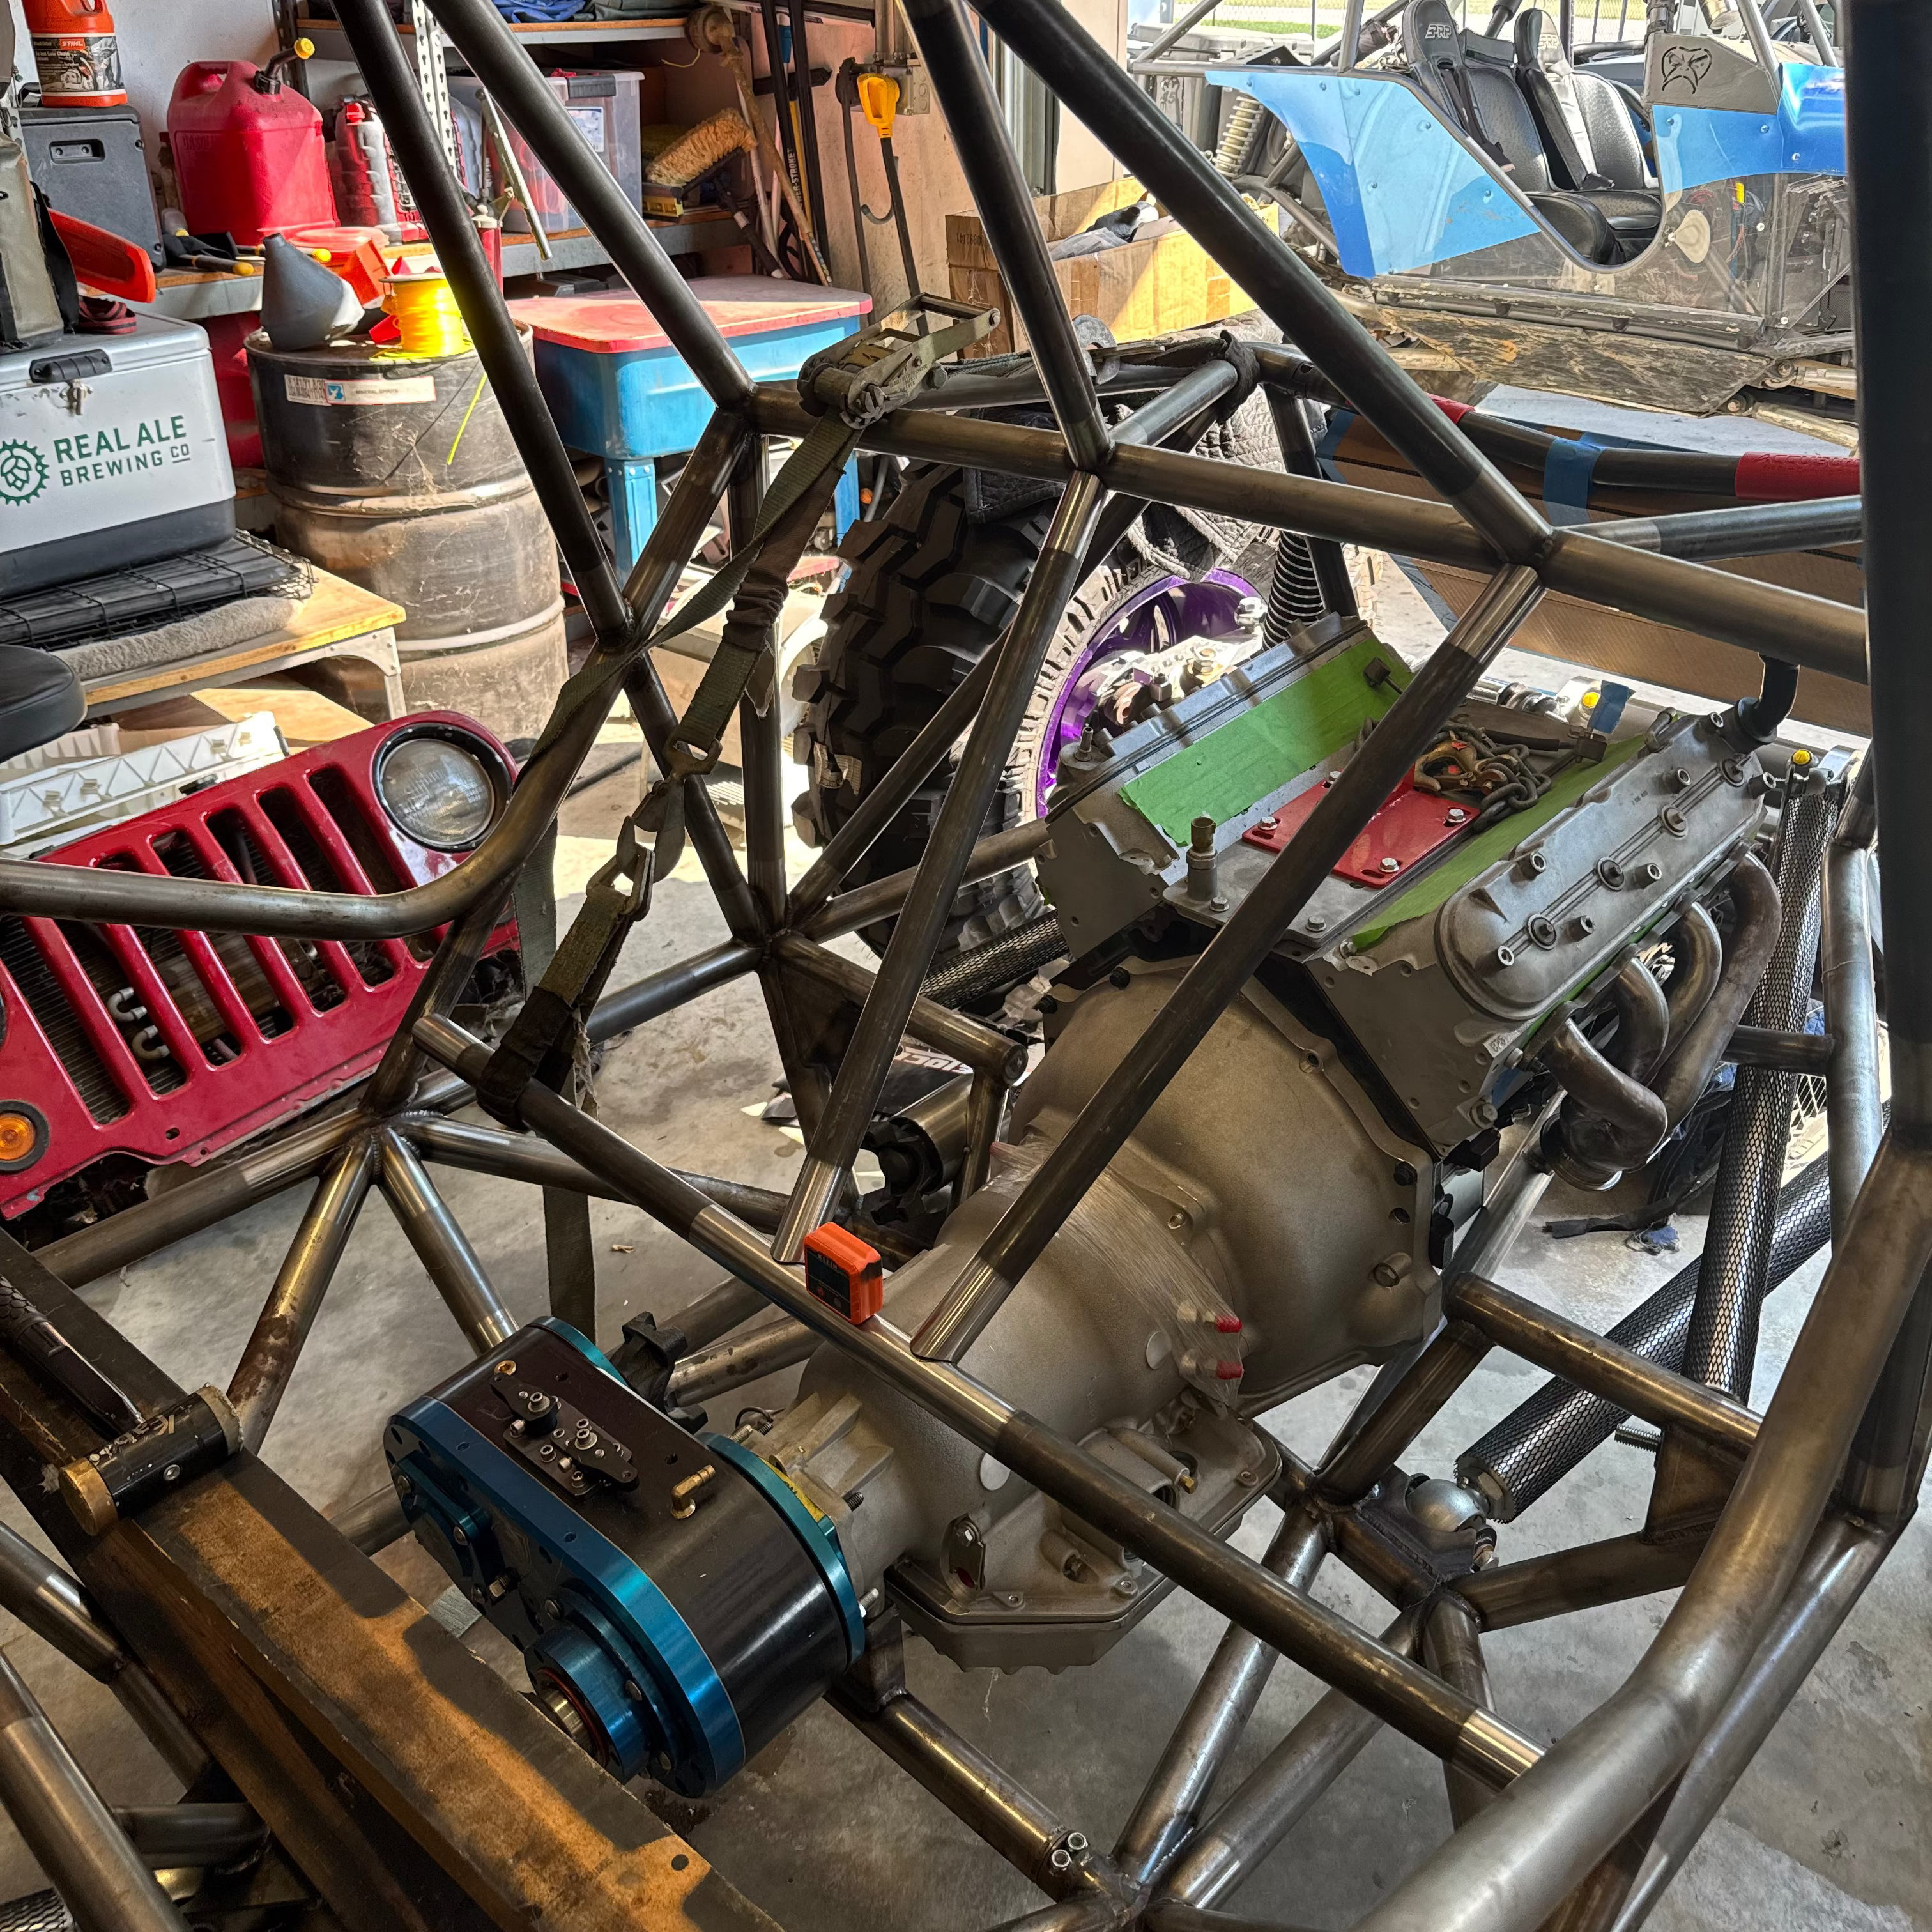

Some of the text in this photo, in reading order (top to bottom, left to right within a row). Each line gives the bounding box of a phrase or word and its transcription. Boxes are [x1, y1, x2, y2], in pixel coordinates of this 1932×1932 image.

[53, 415, 187, 464] REAL ALE
[60, 443, 190, 487] BREWING CO
[817, 1253, 838, 1270] KLEIN
